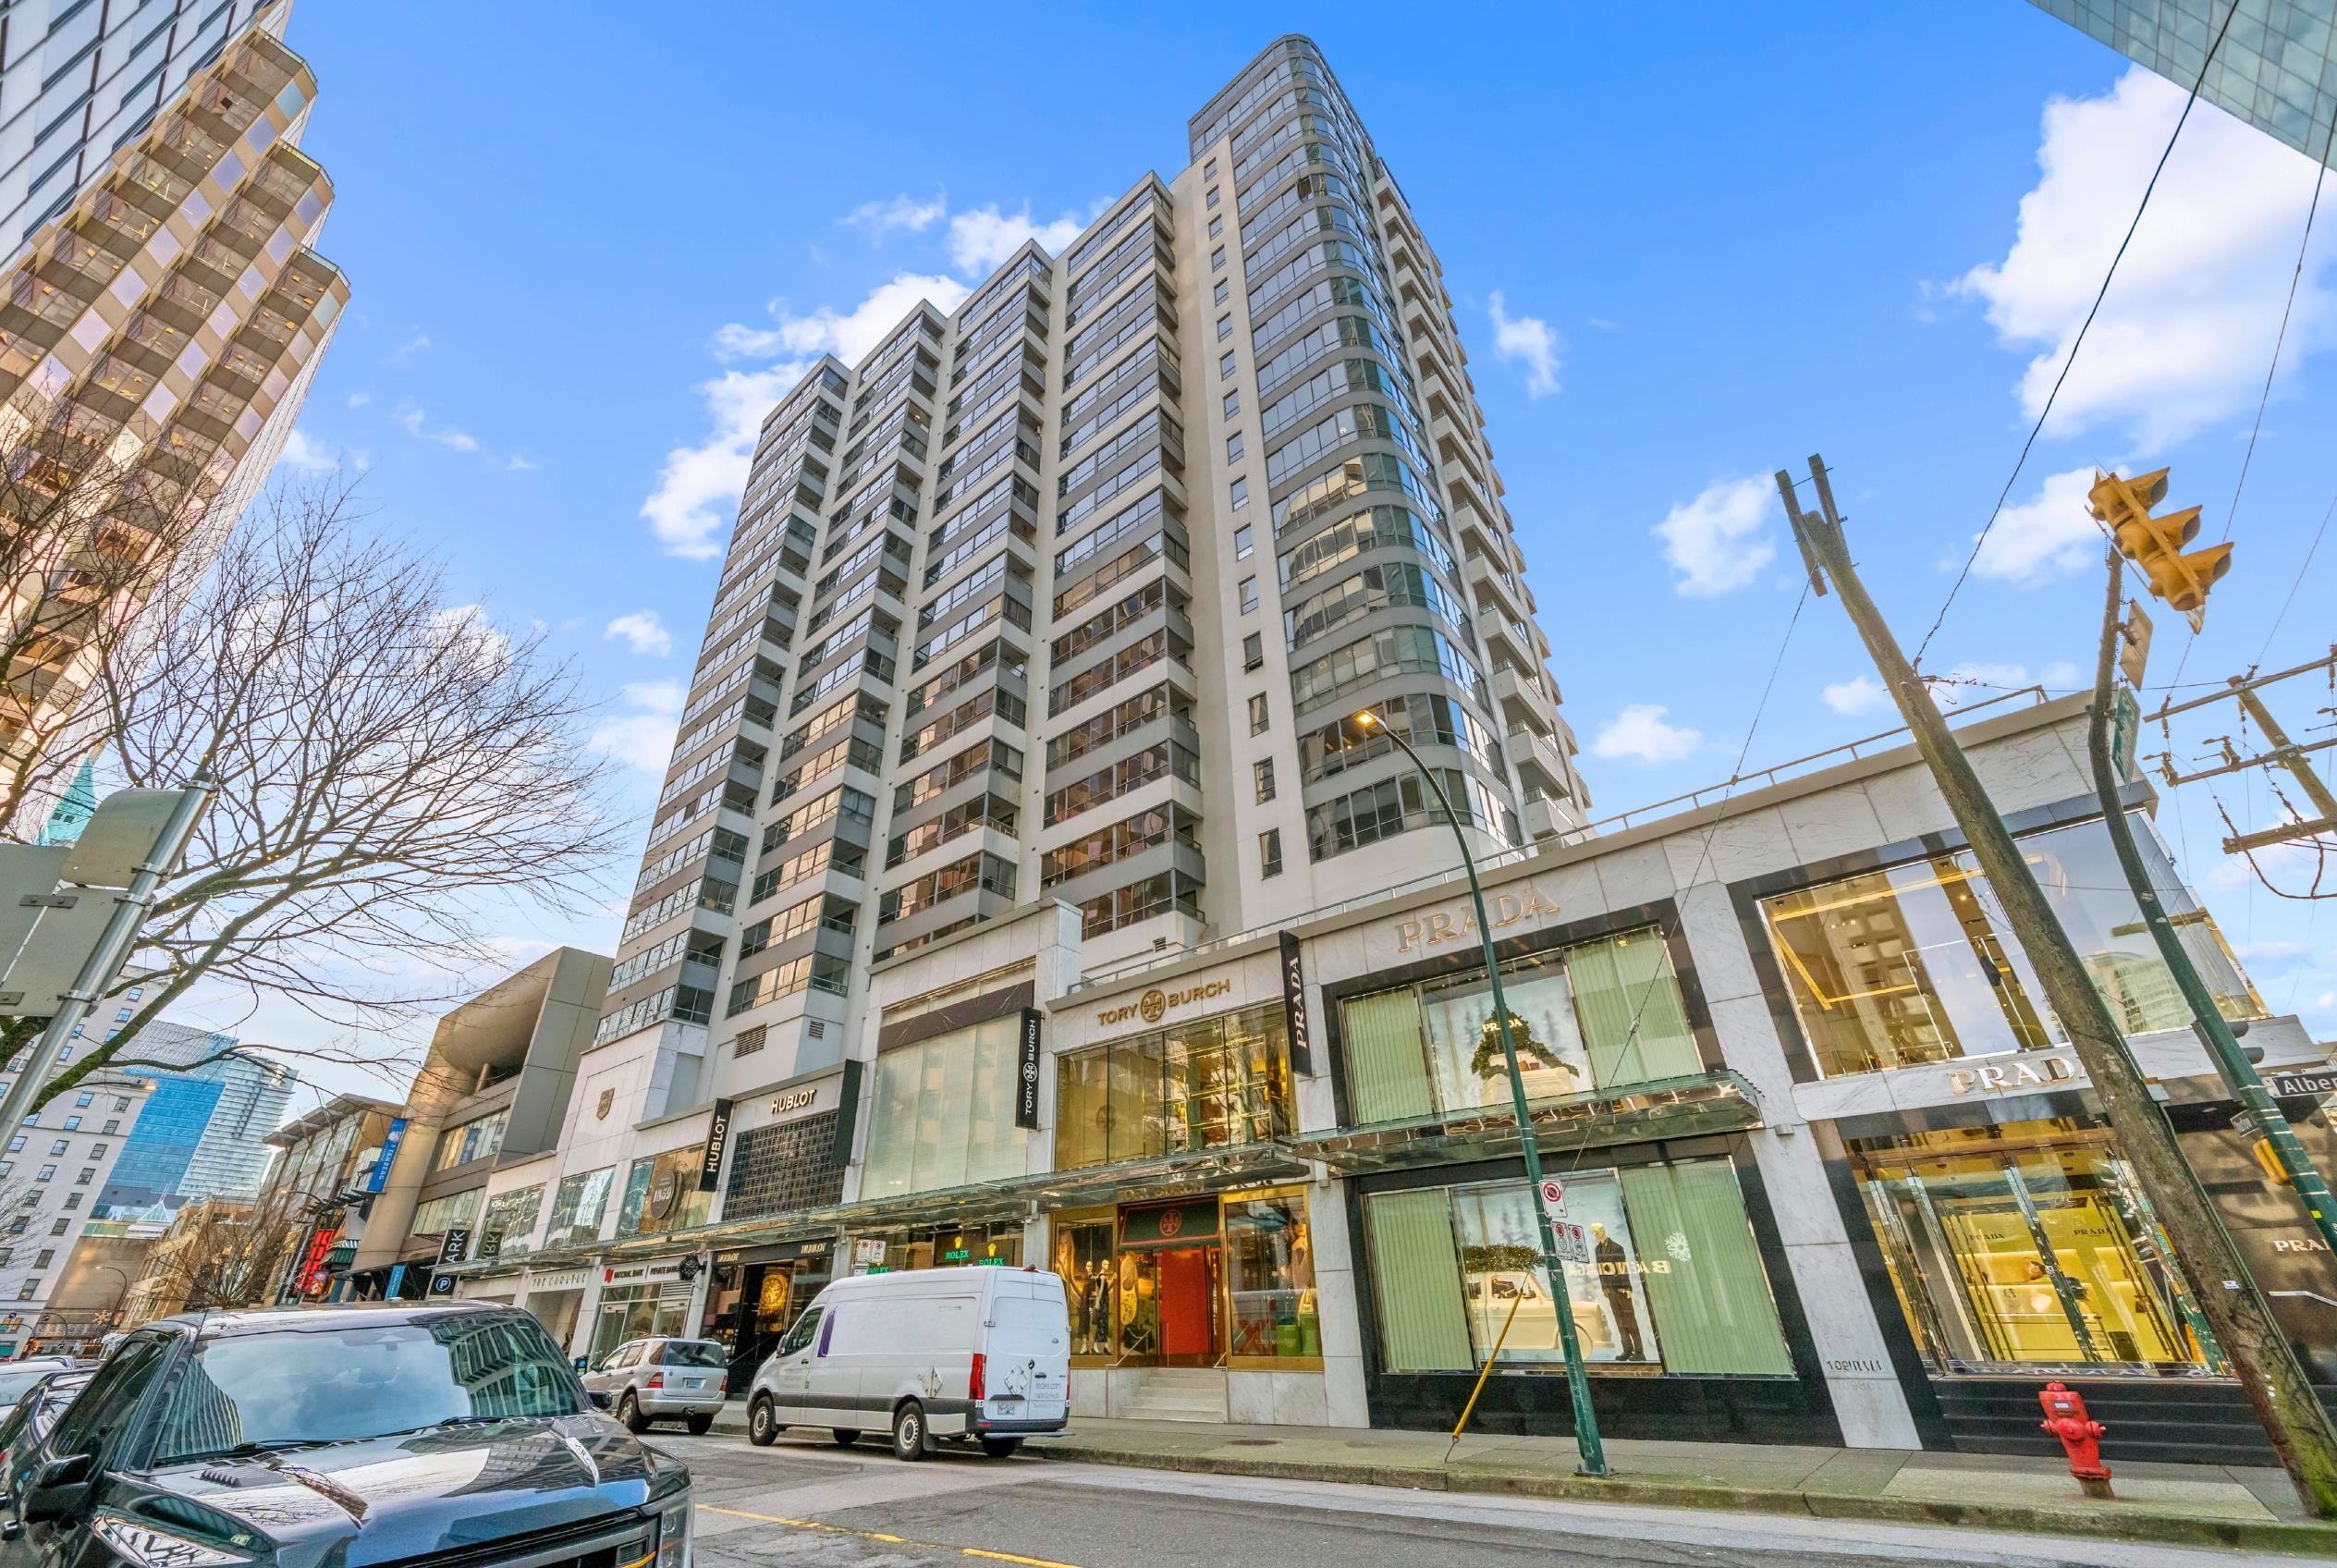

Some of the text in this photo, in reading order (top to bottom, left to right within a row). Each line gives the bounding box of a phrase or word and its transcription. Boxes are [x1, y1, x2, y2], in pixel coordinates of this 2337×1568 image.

[1097, 978, 1231, 1026] TORY BURCH
[1289, 956, 1308, 1049] PRADA
[1482, 1018, 1523, 1033] PRDA
[1024, 1019, 1036, 1115] TORY BURCH
[1946, 1057, 2087, 1096] PRAD
[770, 1089, 817, 1114] HUBLOT
[706, 1115, 728, 1173] HUBLOT
[1969, 1232, 2005, 1241] PRADA
[2272, 1240, 2331, 1253] PRA
[946, 1249, 970, 1260] ROLEX
